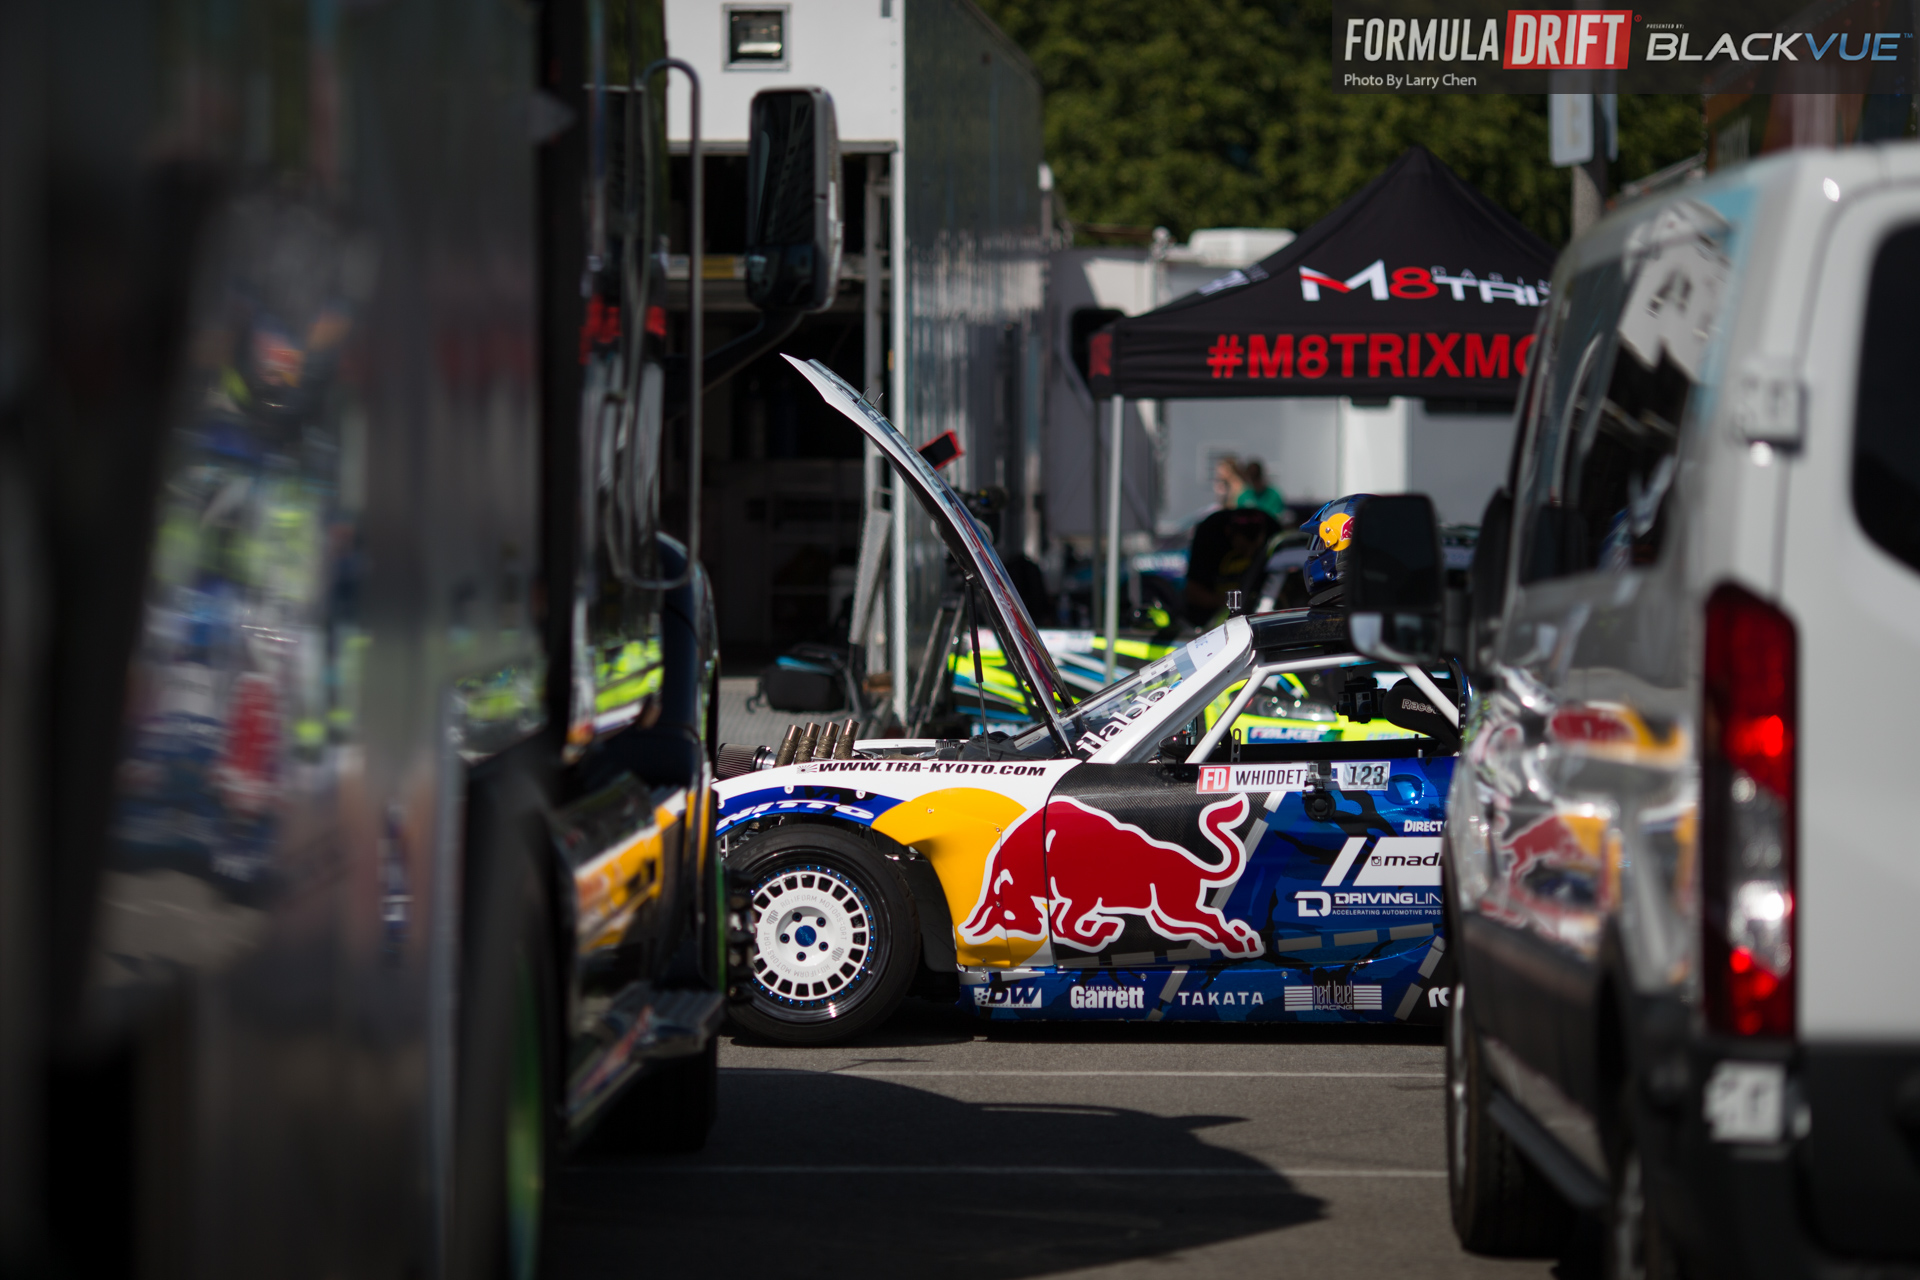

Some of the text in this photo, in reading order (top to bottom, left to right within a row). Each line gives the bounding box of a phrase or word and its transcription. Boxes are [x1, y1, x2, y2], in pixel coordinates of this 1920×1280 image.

[1401, 698, 1436, 714] Race
[818, 762, 1047, 776] WWW.TRA-KYOTO.COM
[1202, 767, 1228, 791] FD
[1348, 765, 1385, 786] 123
[715, 799, 875, 831] NITTO
[1403, 819, 1443, 832] DIRECT
[1384, 853, 1443, 867] mad
[1070, 985, 1144, 1009] Garrett
[1178, 991, 1264, 1006] TAKATA
